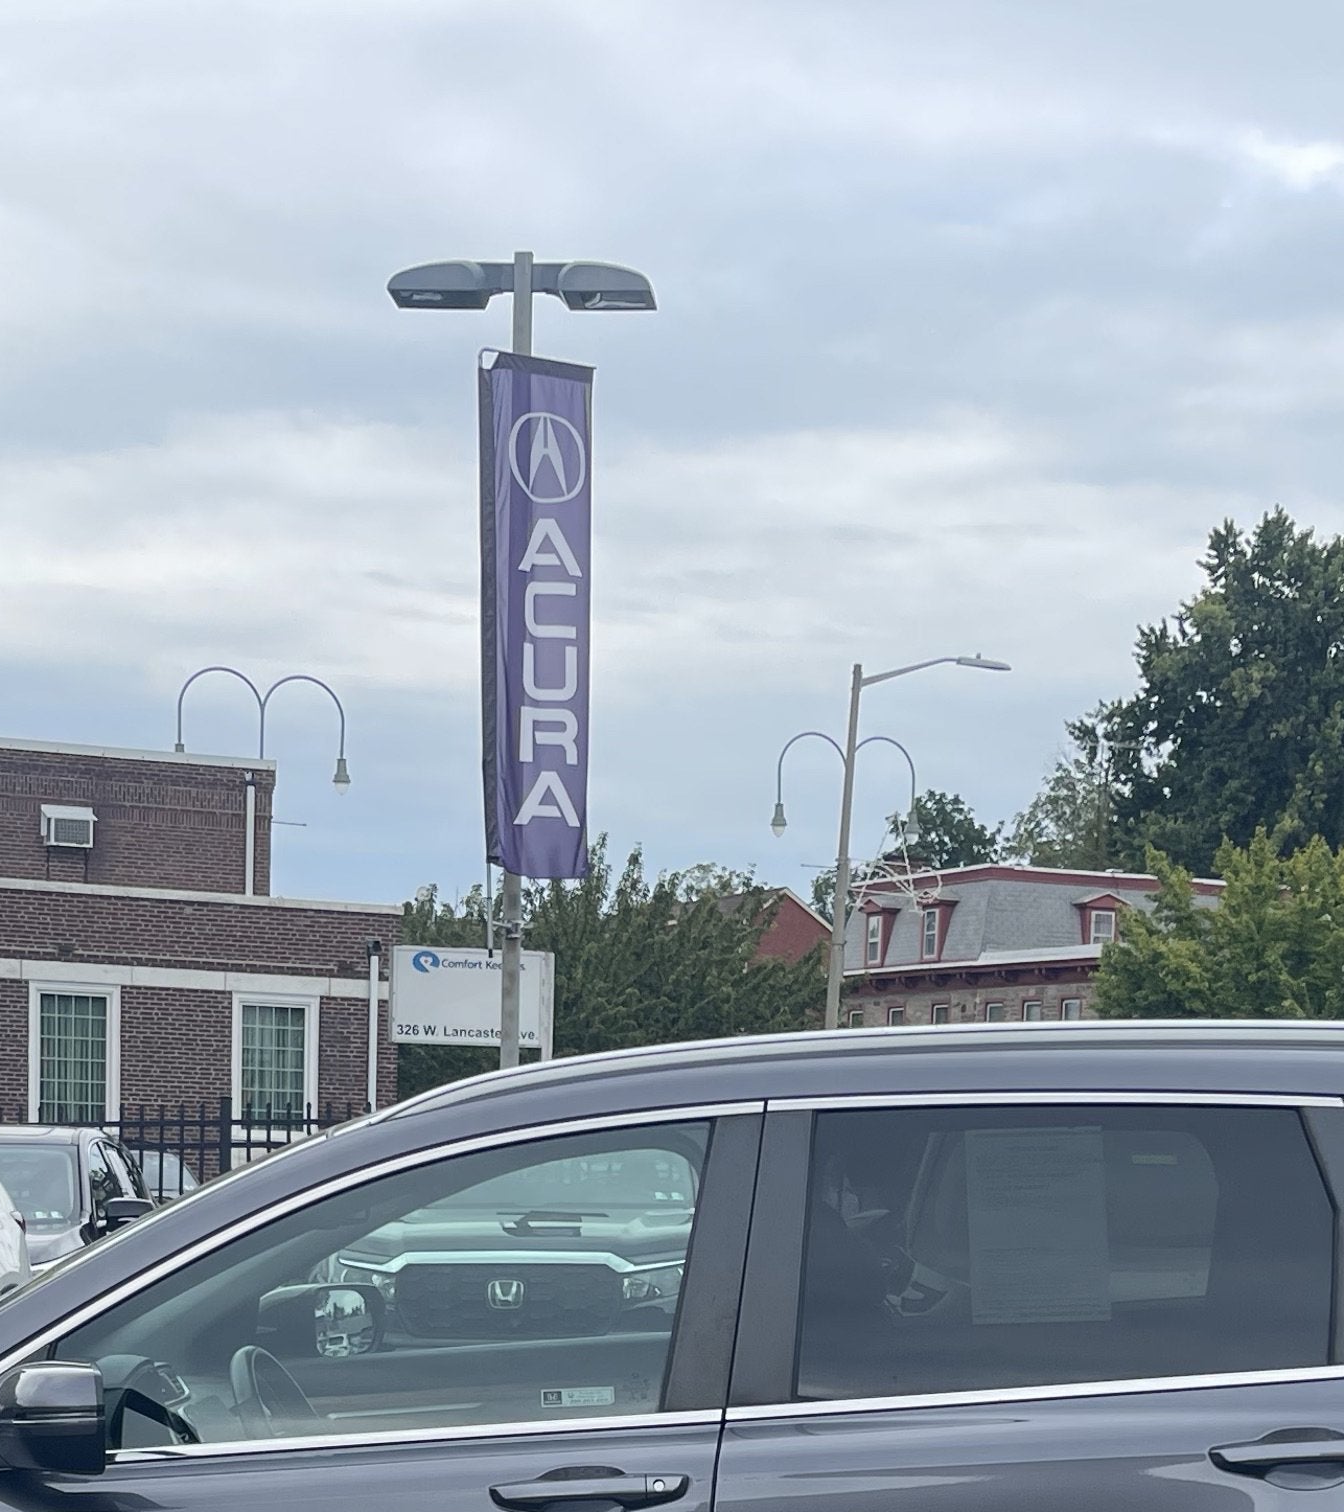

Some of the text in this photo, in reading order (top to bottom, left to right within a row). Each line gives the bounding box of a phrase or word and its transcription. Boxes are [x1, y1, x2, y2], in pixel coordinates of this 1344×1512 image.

[512, 518, 583, 828] ACURA
[441, 959, 526, 971] Comfort Kees
[397, 1024, 420, 1036] 326
[444, 1026, 503, 1039] Lancaste
